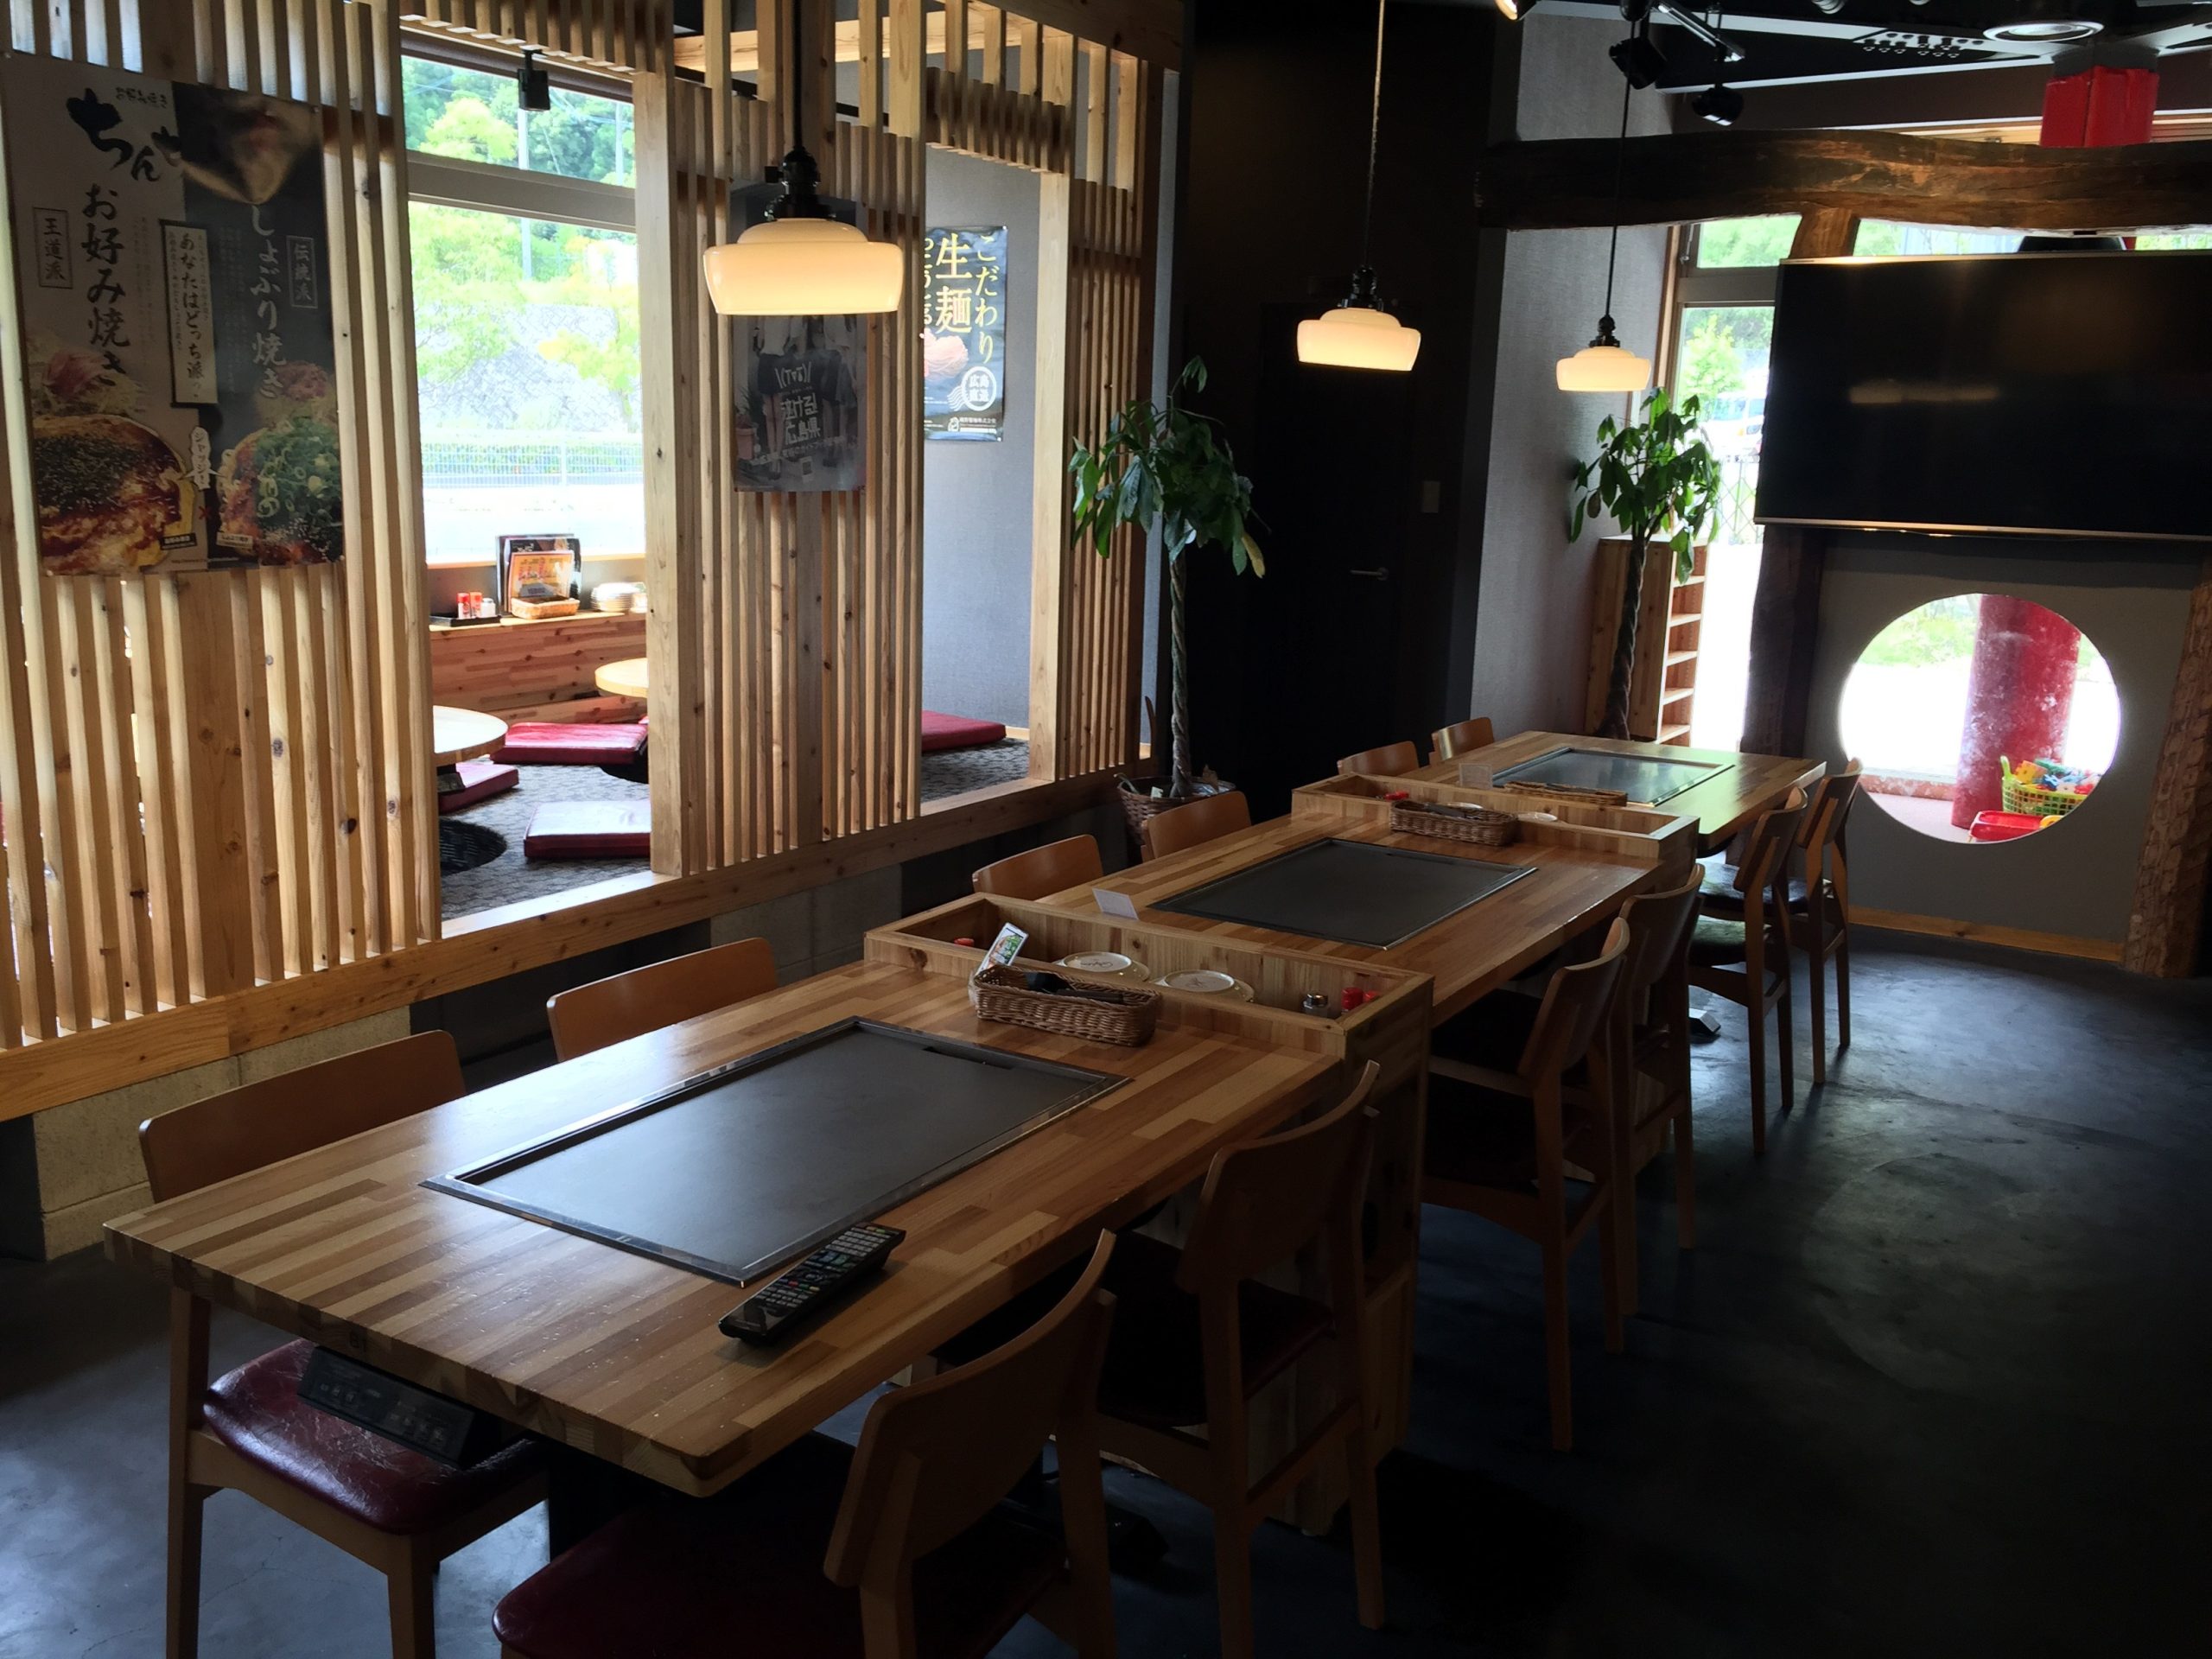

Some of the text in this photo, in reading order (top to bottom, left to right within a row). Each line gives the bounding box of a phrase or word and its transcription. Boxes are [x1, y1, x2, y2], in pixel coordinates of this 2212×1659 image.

[43, 218, 66, 281] 王道派
[81, 183, 130, 386] お好み焼き
[935, 232, 973, 334] 生麺
[974, 234, 999, 365] こだわり
[785, 416, 822, 446] 広島県
